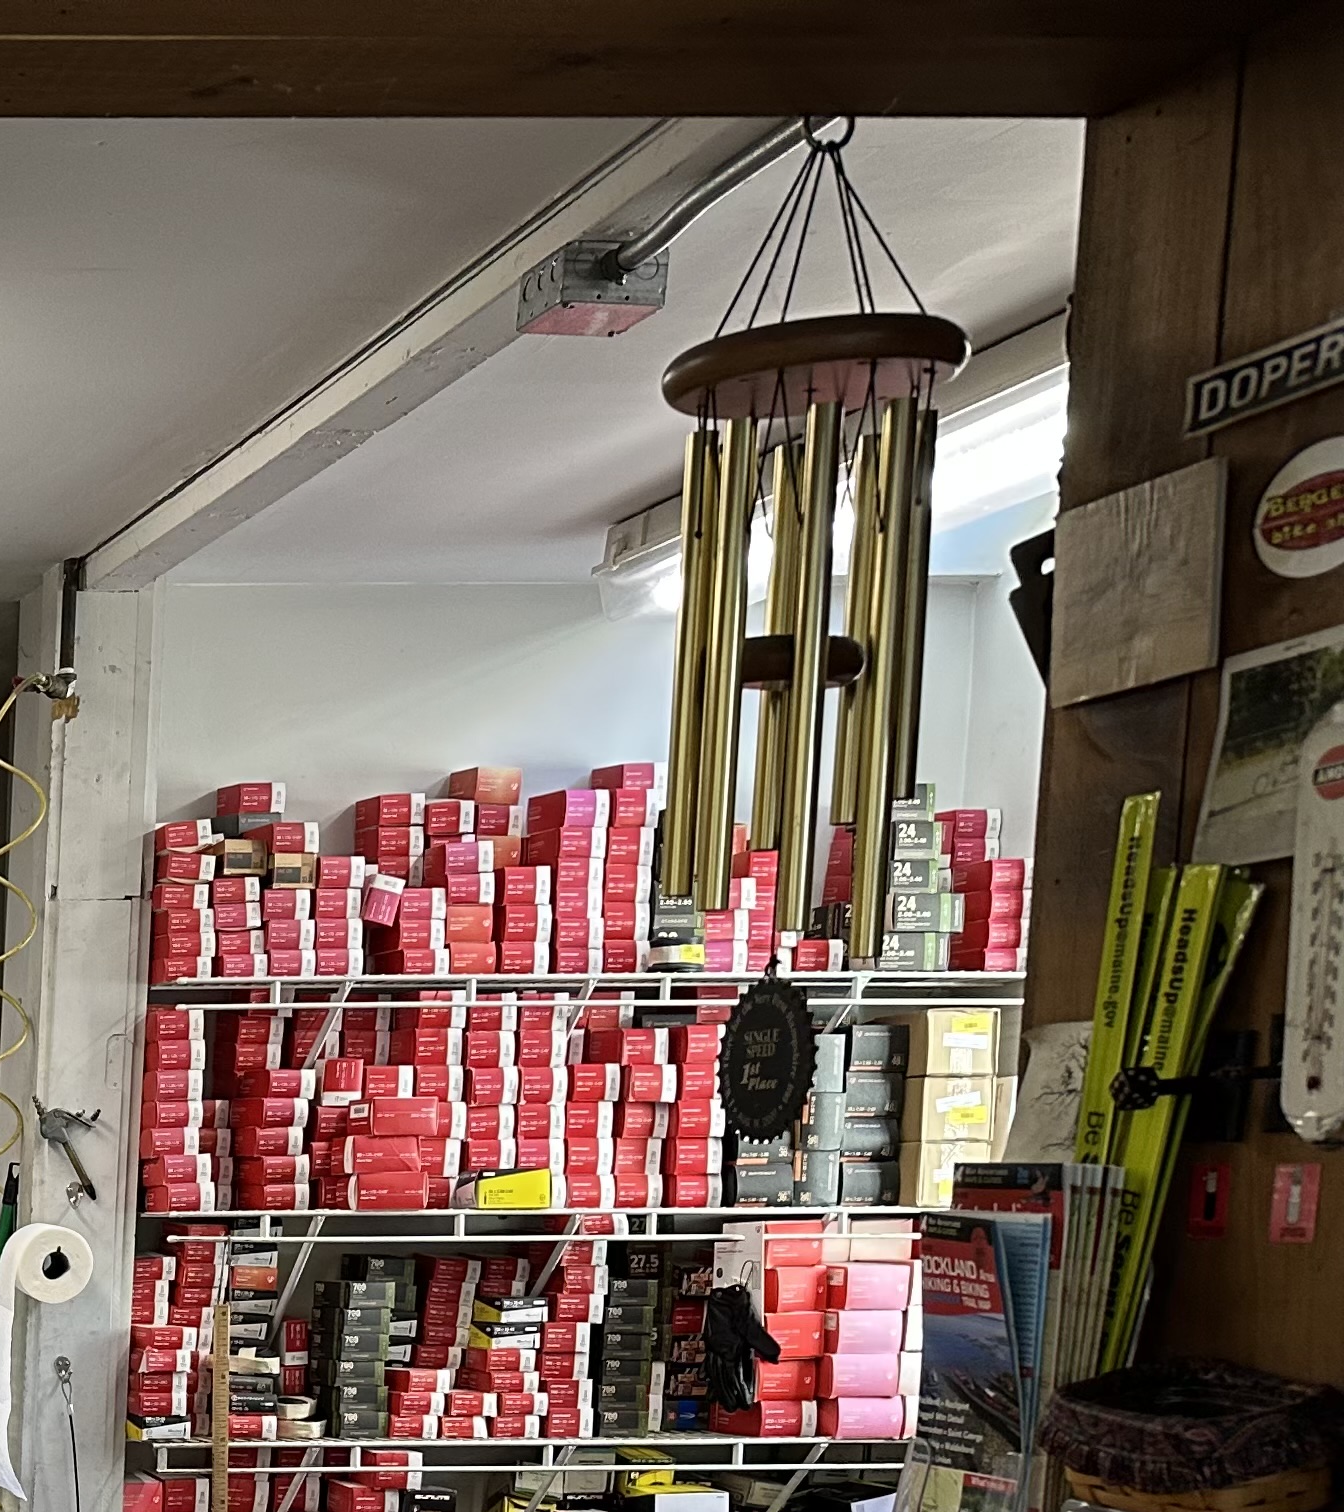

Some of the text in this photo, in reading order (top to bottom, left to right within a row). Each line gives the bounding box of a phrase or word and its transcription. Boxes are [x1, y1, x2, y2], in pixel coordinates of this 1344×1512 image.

[898, 823, 916, 838] 24
[893, 861, 911, 876] 24
[897, 896, 916, 911] 24
[882, 935, 899, 951] 24
[631, 1217, 646, 1231] 27
[630, 1253, 659, 1268] 27.5
